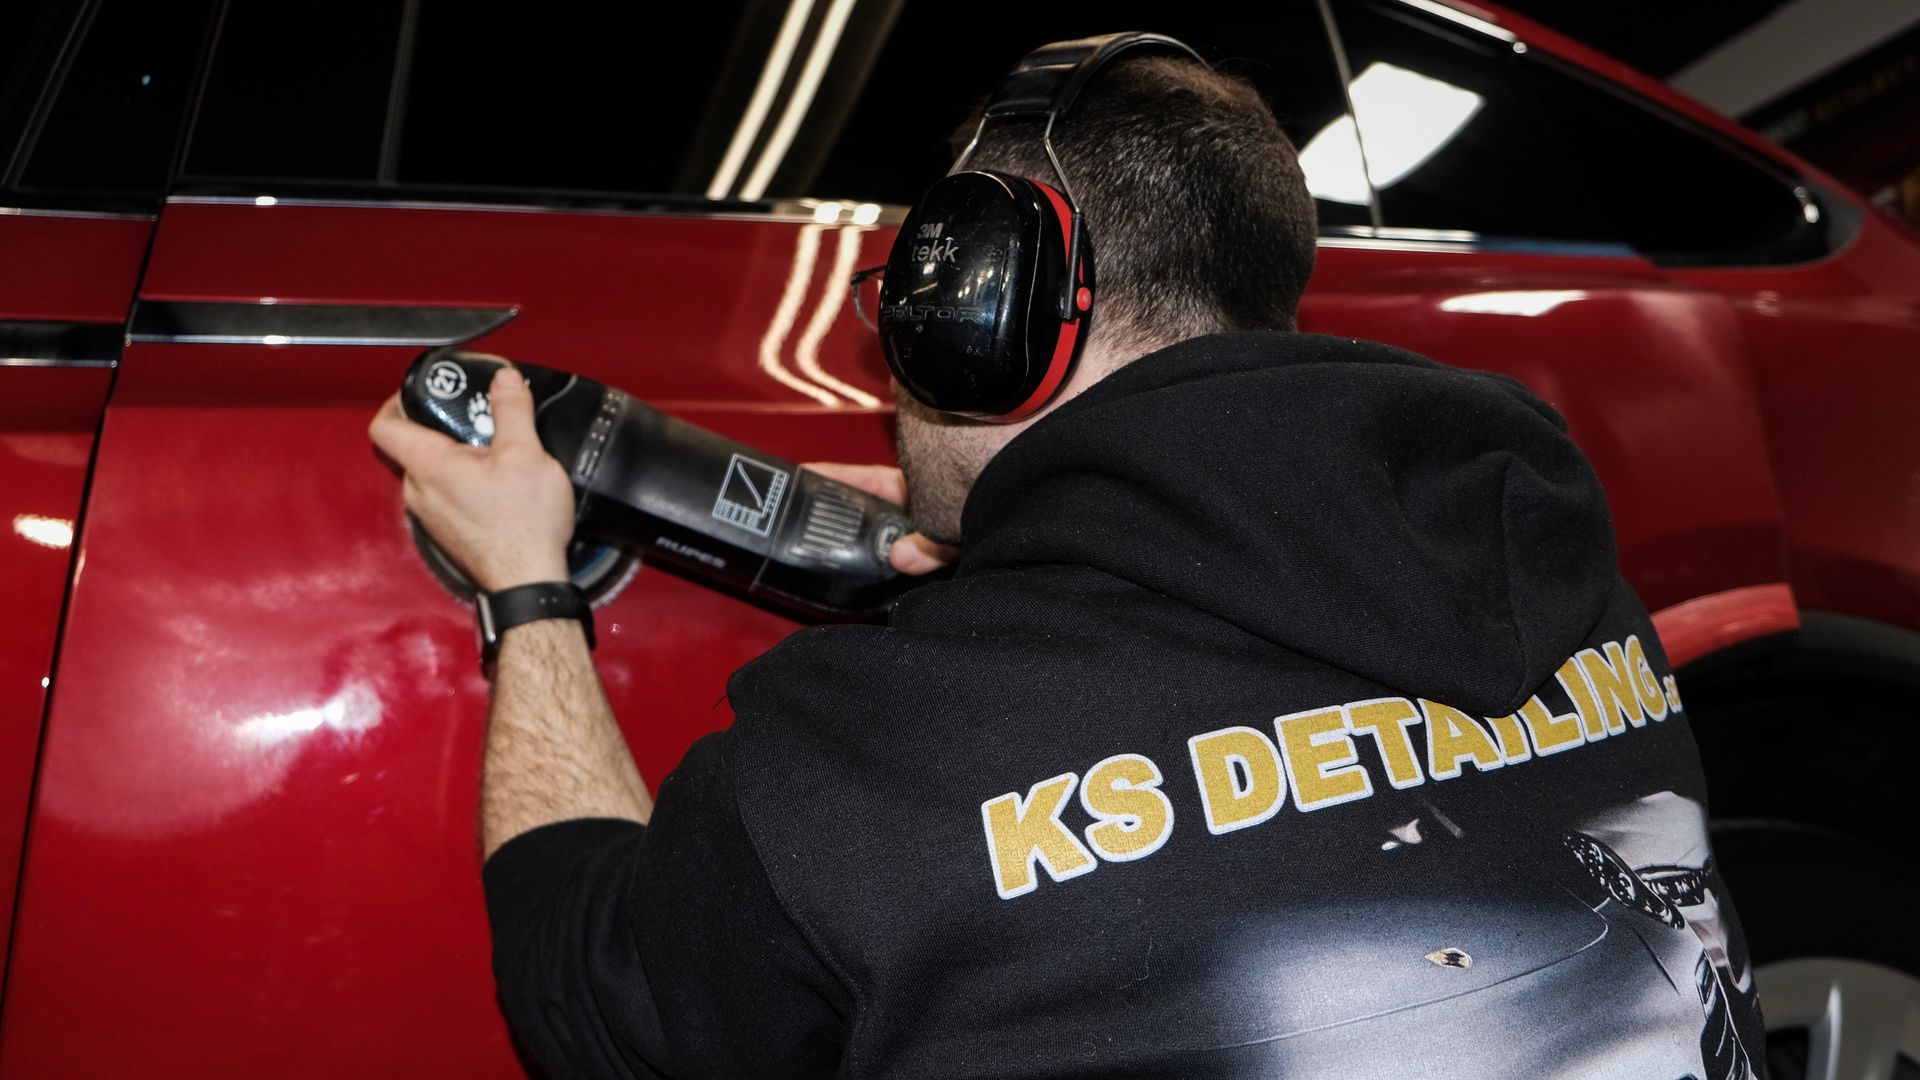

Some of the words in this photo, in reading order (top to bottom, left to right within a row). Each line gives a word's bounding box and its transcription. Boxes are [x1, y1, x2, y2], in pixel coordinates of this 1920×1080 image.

[916, 222, 944, 239] 3M
[911, 238, 960, 263] tekk
[883, 304, 985, 324] PELTOR
[433, 367, 458, 394] 21
[655, 535, 727, 570] RUPES
[981, 753, 1174, 900] KS
